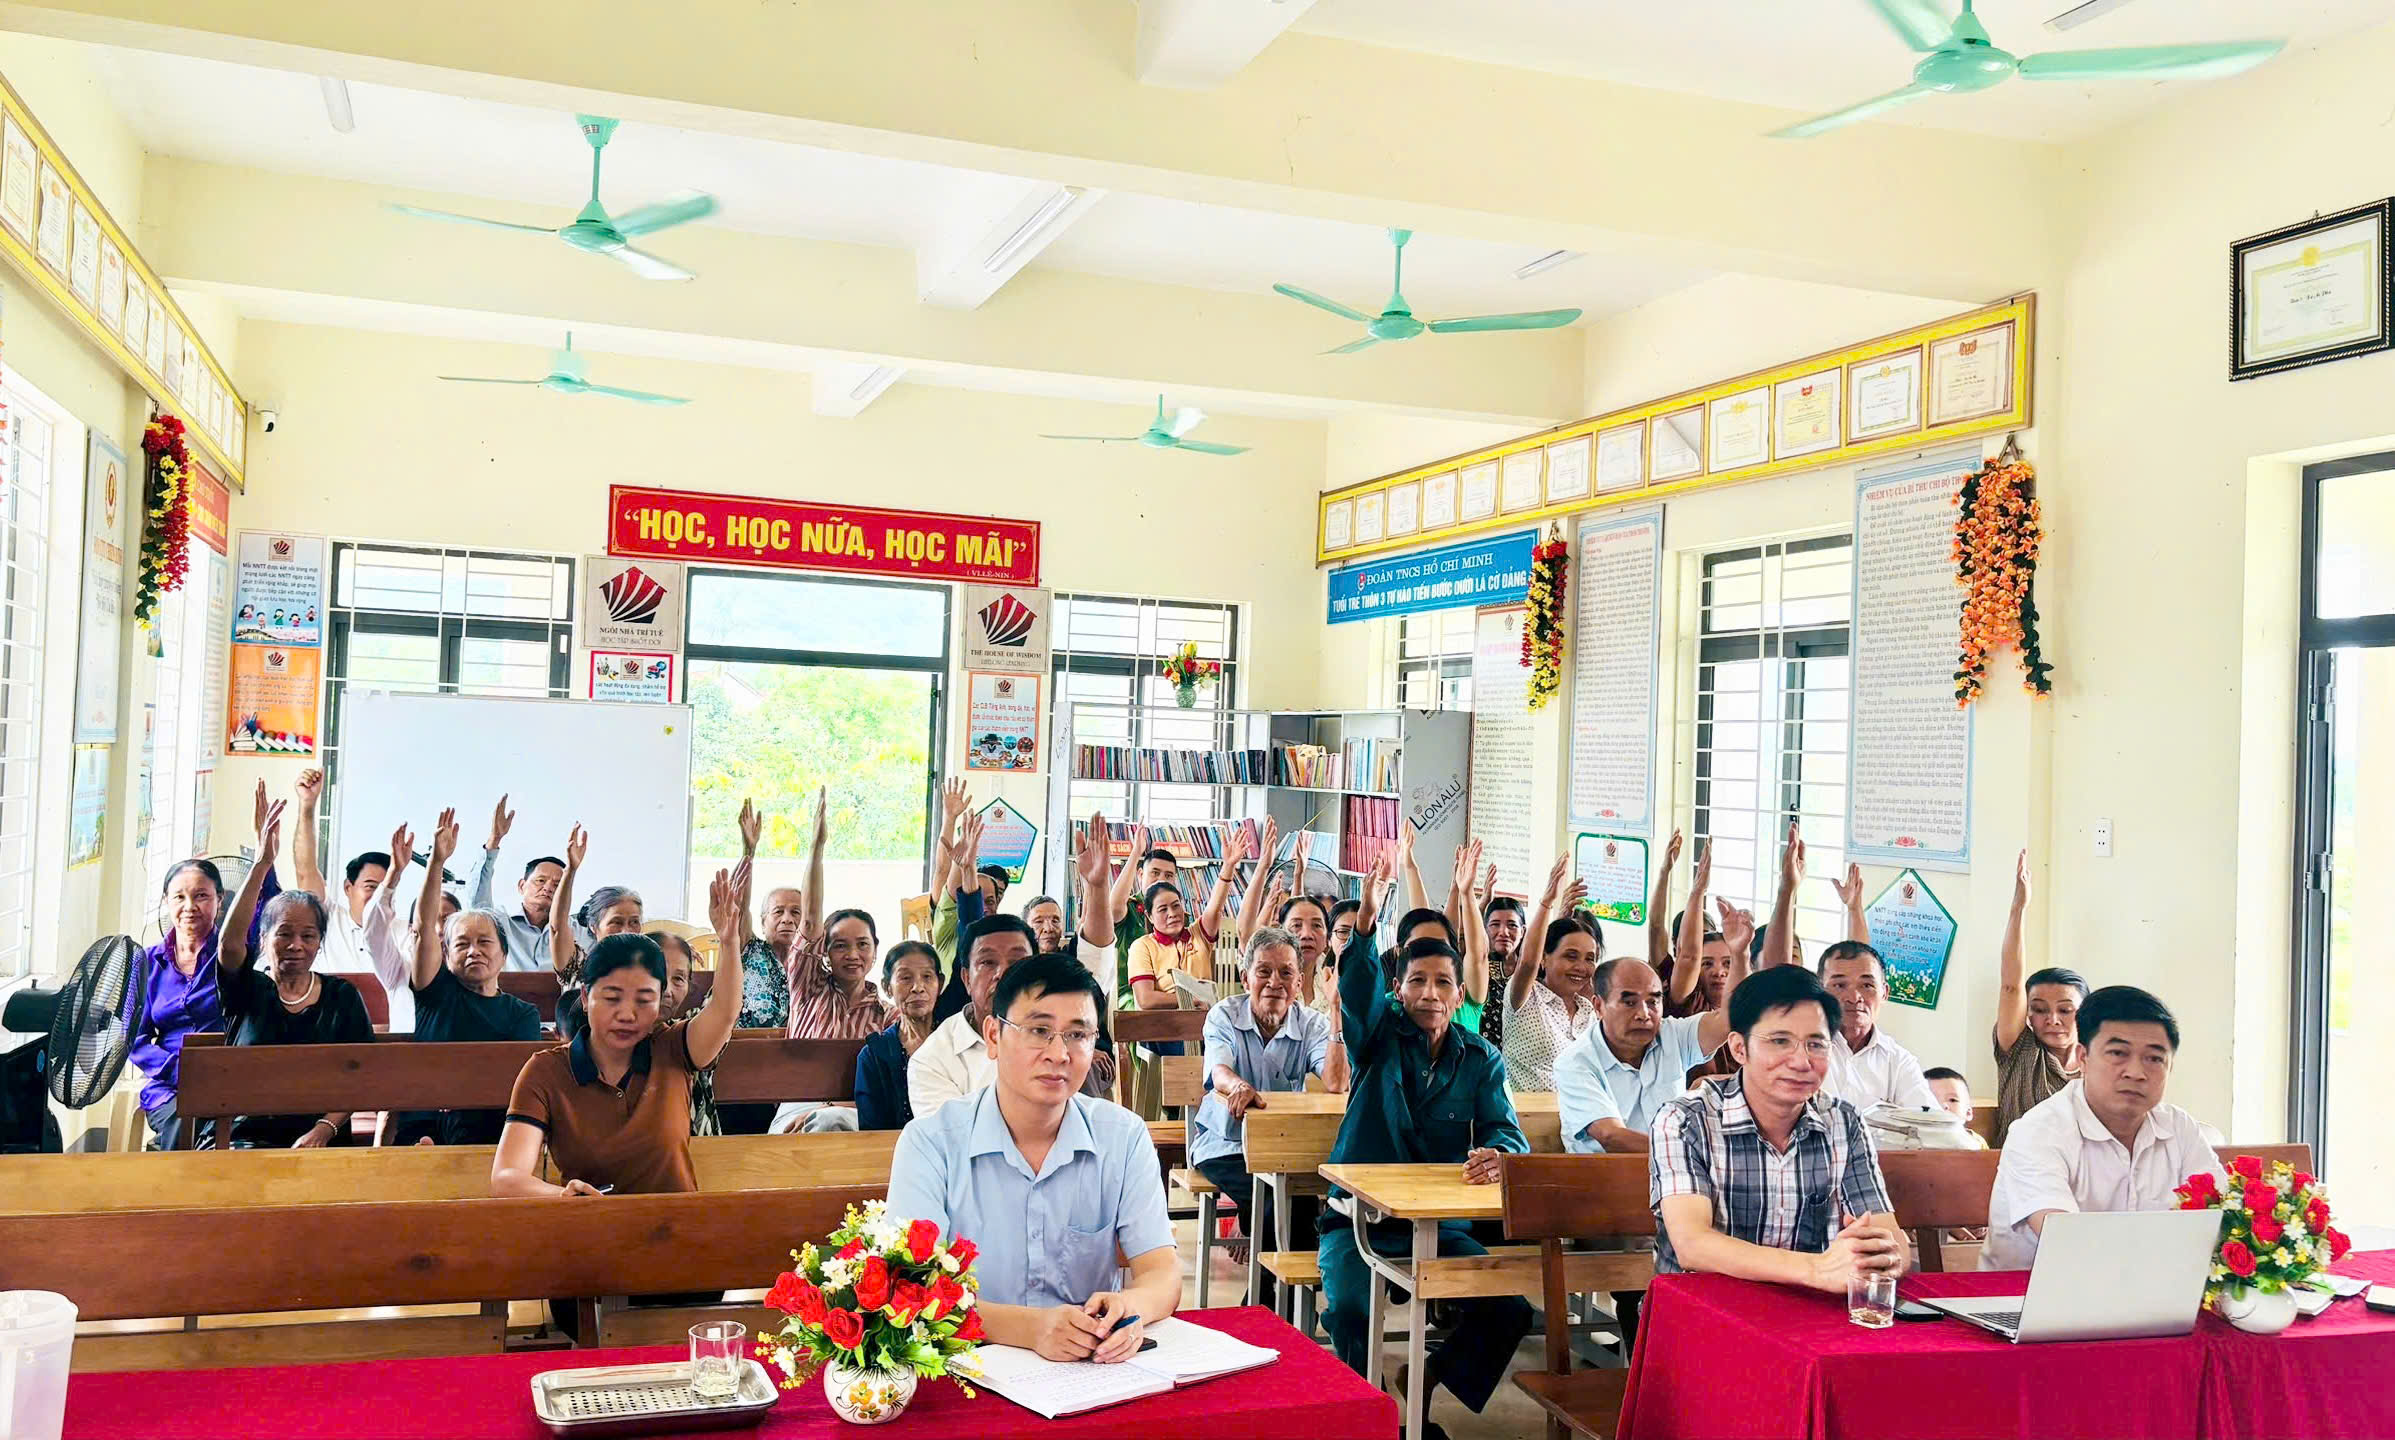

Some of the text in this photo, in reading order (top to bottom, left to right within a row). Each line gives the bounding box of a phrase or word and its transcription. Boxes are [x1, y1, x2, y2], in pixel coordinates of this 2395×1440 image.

[624, 508, 1026, 568] “HỌC, HỌC NỮA, HỌC MÃI”
[1366, 553, 1494, 585] ĐOÀN TNCS HỒ CHÍ MINH
[1380, 592, 1386, 606] 3
[1413, 581, 1430, 601] TIẾN
[1431, 578, 1453, 599] BƯỚC
[1475, 573, 1486, 592] LÁ
[1488, 570, 1501, 591] CỜ
